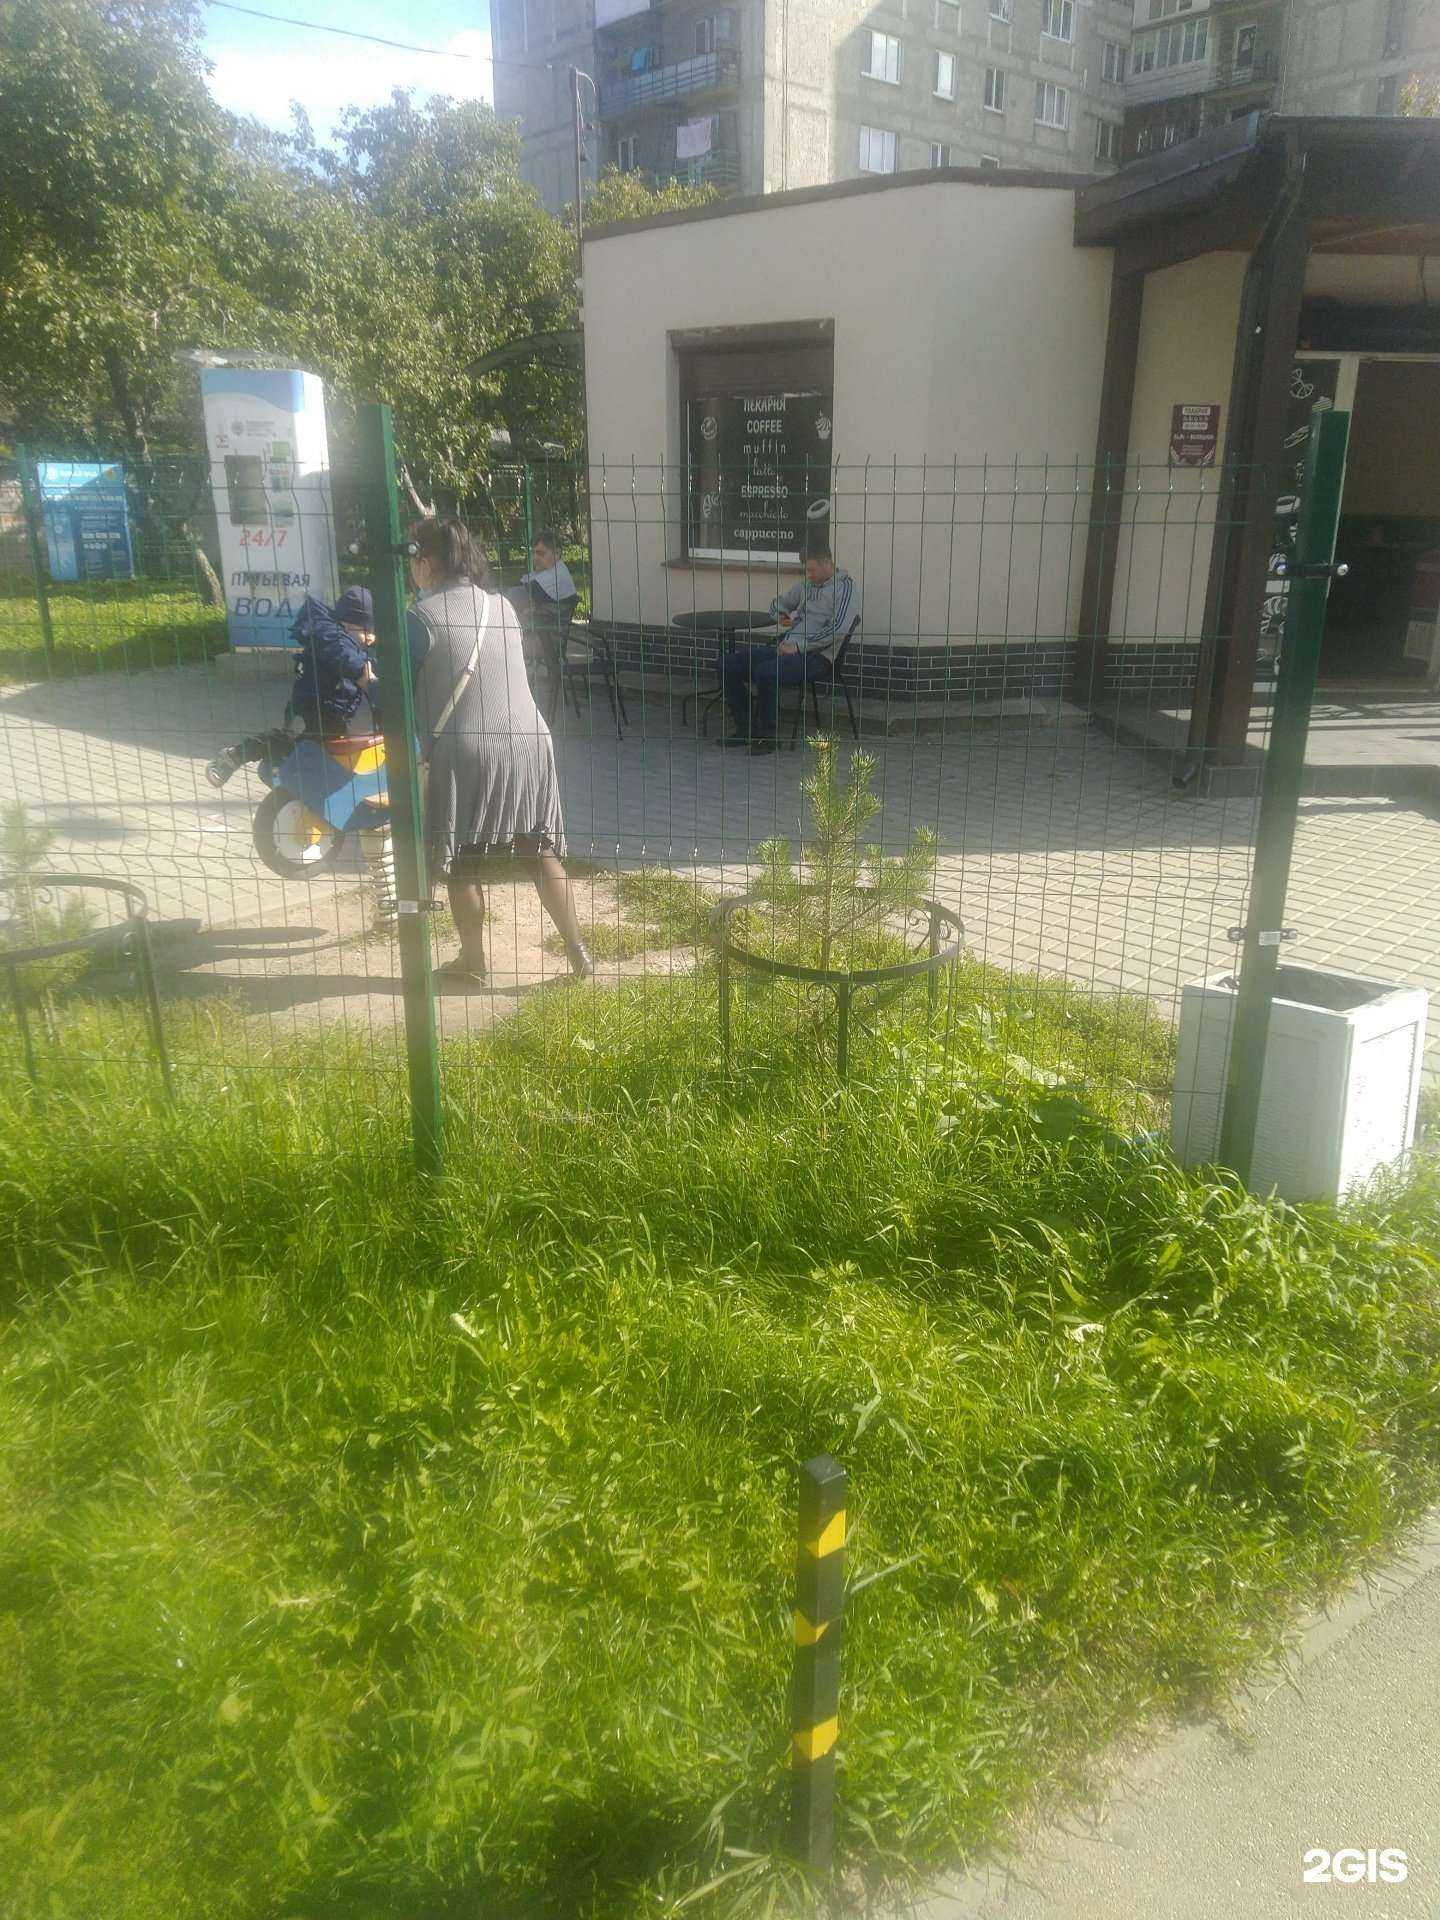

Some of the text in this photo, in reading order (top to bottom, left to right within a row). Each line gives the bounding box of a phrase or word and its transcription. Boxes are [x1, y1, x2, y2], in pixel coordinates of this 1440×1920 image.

[743, 399, 787, 412] ПЕКАРНЯ
[746, 419, 783, 434] COFFEE
[743, 439, 787, 454] muffin
[741, 485, 789, 499] ESPRESSO
[239, 528, 289, 547] 24/7
[734, 528, 794, 542] cappuccino
[230, 572, 312, 588] ПИТЬЕВАЯ
[233, 597, 297, 618] ВОД
